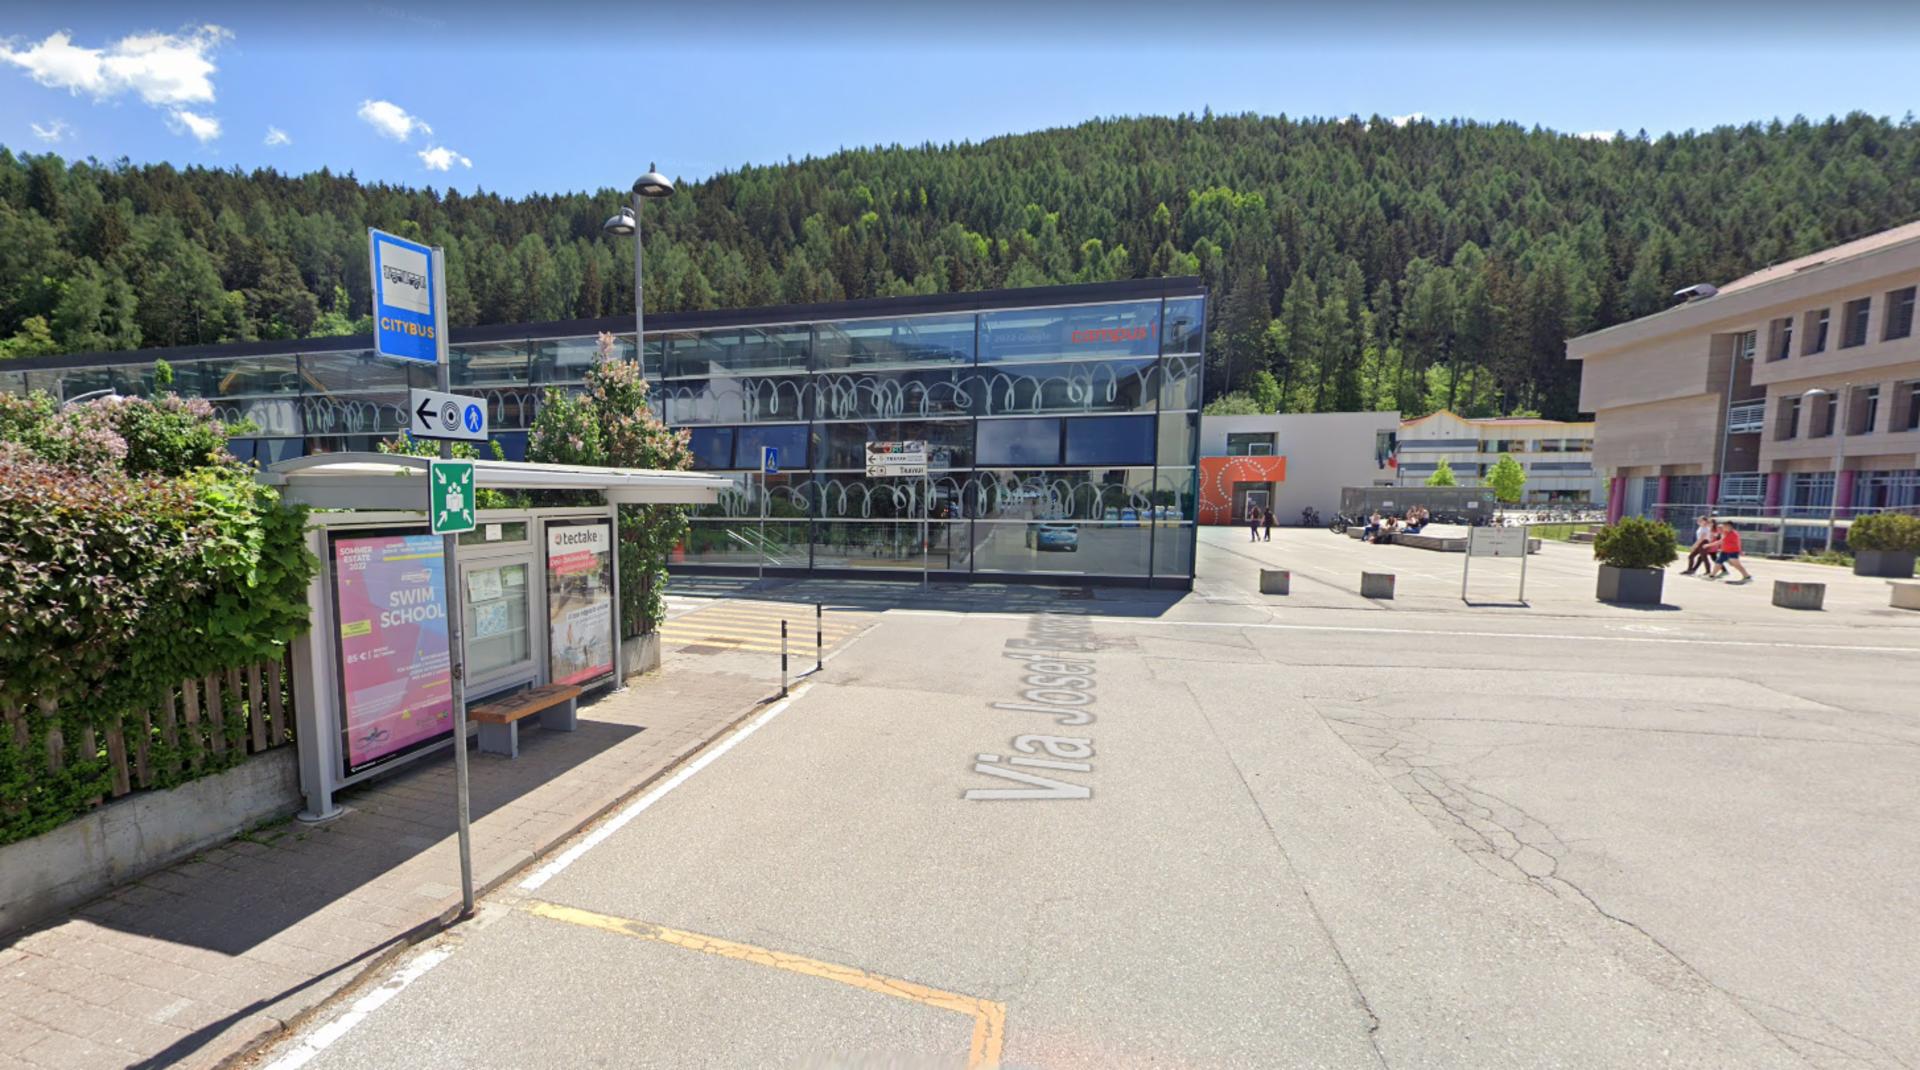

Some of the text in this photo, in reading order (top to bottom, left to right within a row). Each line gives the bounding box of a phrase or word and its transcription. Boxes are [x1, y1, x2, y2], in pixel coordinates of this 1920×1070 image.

[380, 316, 435, 339] CITYBUS
[563, 529, 598, 544] tectake
[340, 546, 373, 556] SOMMER
[343, 554, 371, 563] ESTATE
[389, 588, 434, 607] SWIM
[380, 604, 446, 628] SCHOOL
